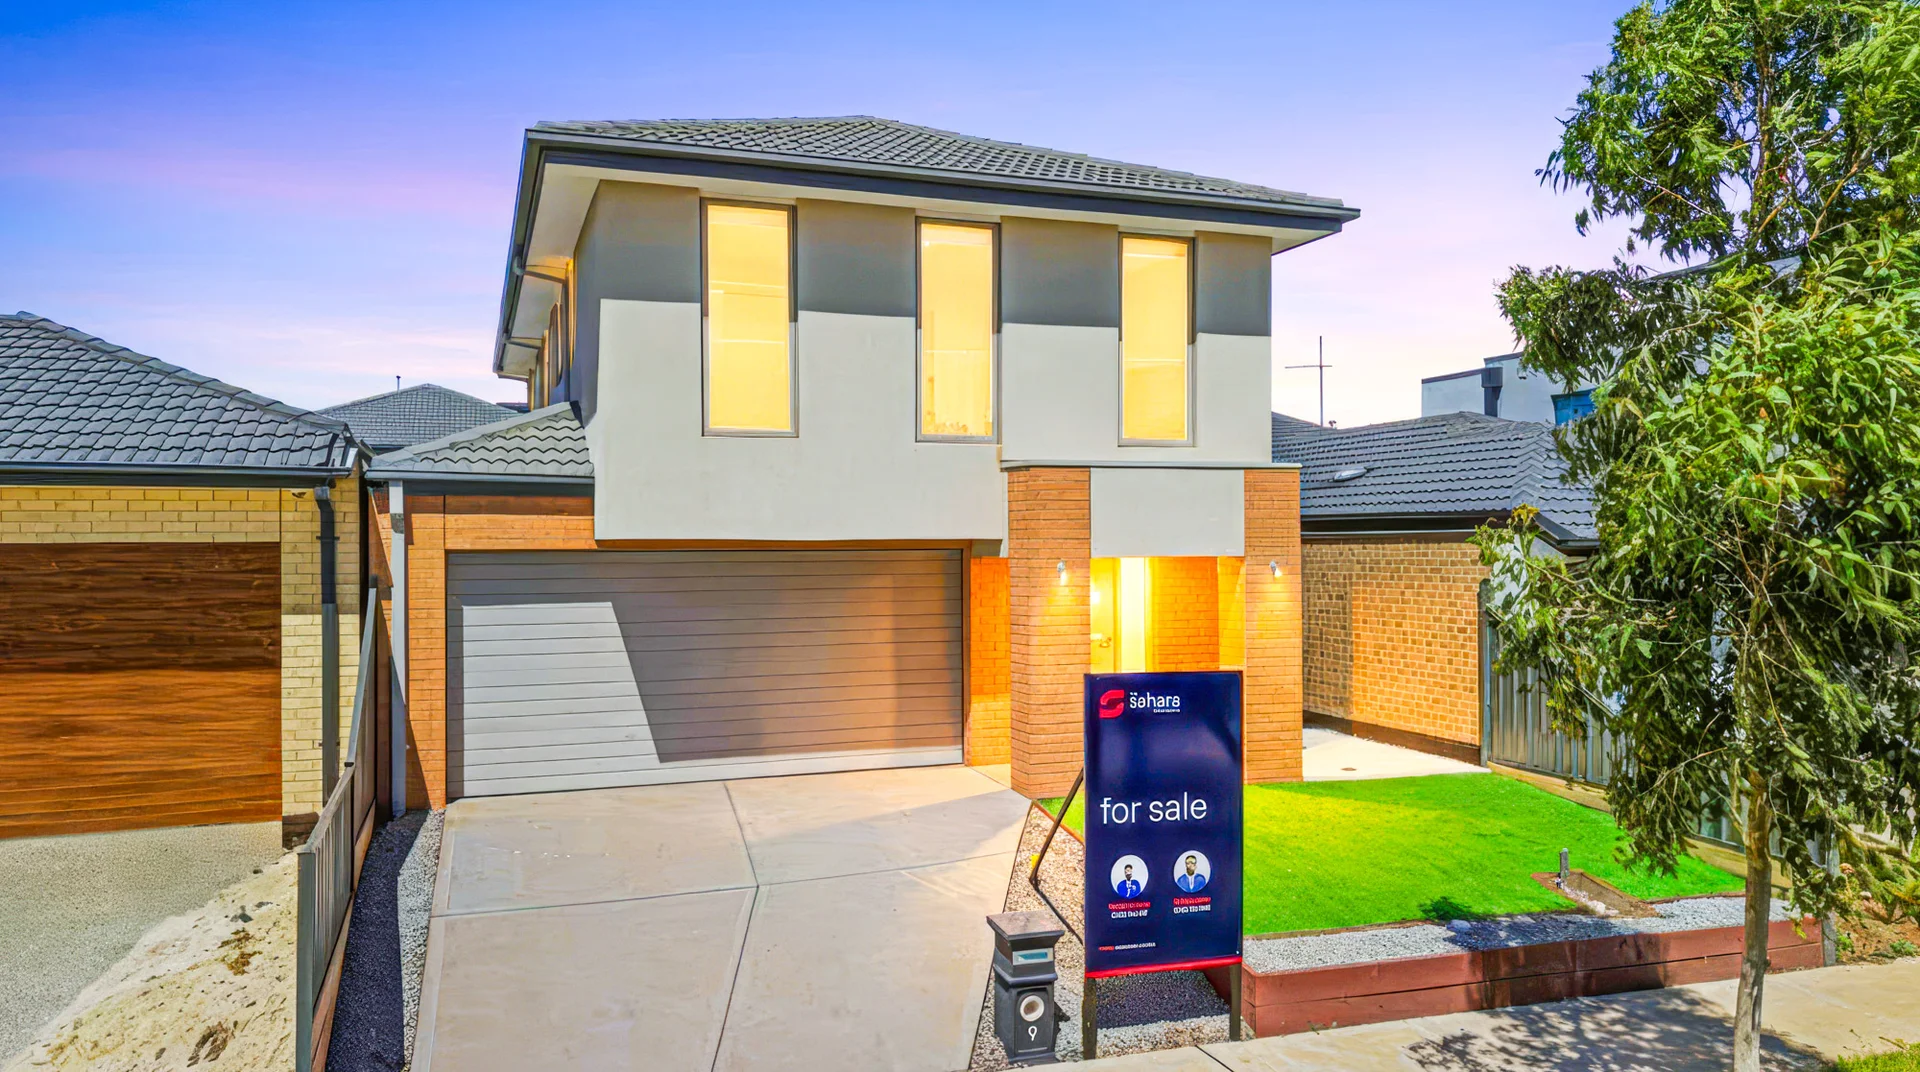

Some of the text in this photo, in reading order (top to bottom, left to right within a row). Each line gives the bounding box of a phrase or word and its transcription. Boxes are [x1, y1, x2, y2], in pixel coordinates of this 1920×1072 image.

[1099, 791, 1207, 825] for sale
[1028, 1025, 1038, 1042] 9
